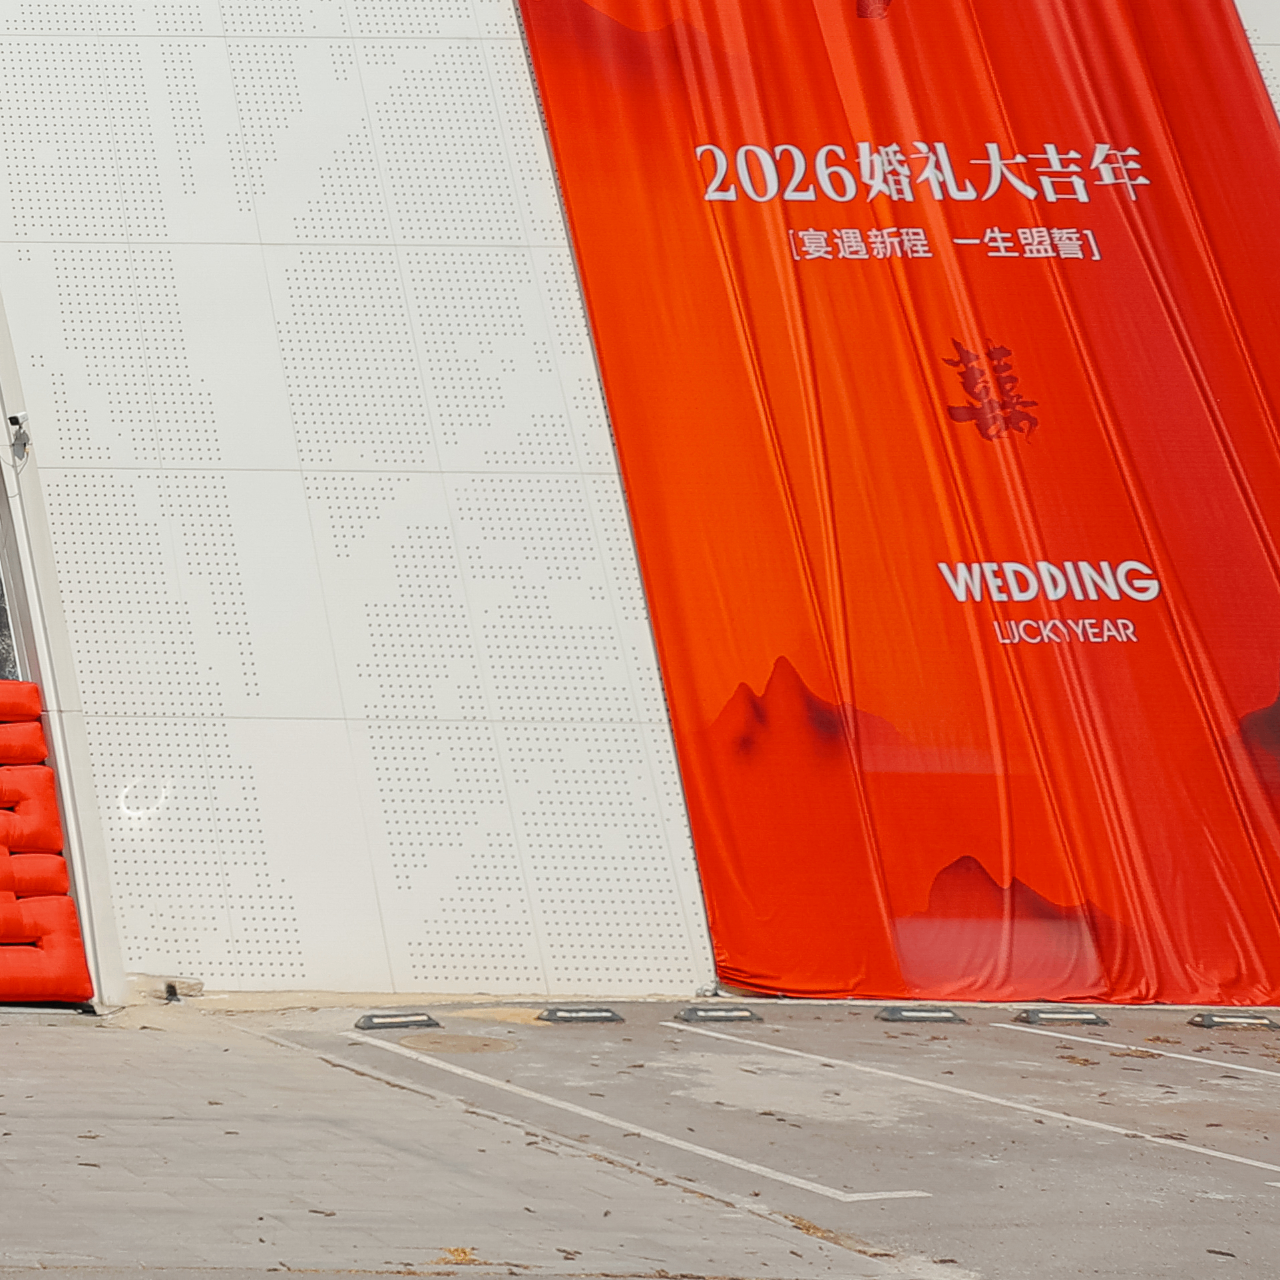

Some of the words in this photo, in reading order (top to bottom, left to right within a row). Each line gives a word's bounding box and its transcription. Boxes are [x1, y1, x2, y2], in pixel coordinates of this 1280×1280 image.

[694, 141, 1150, 202] 2026婚礼大吉年
[938, 561, 1160, 602] WEDDING
[1067, 619, 1138, 642] YEAR
